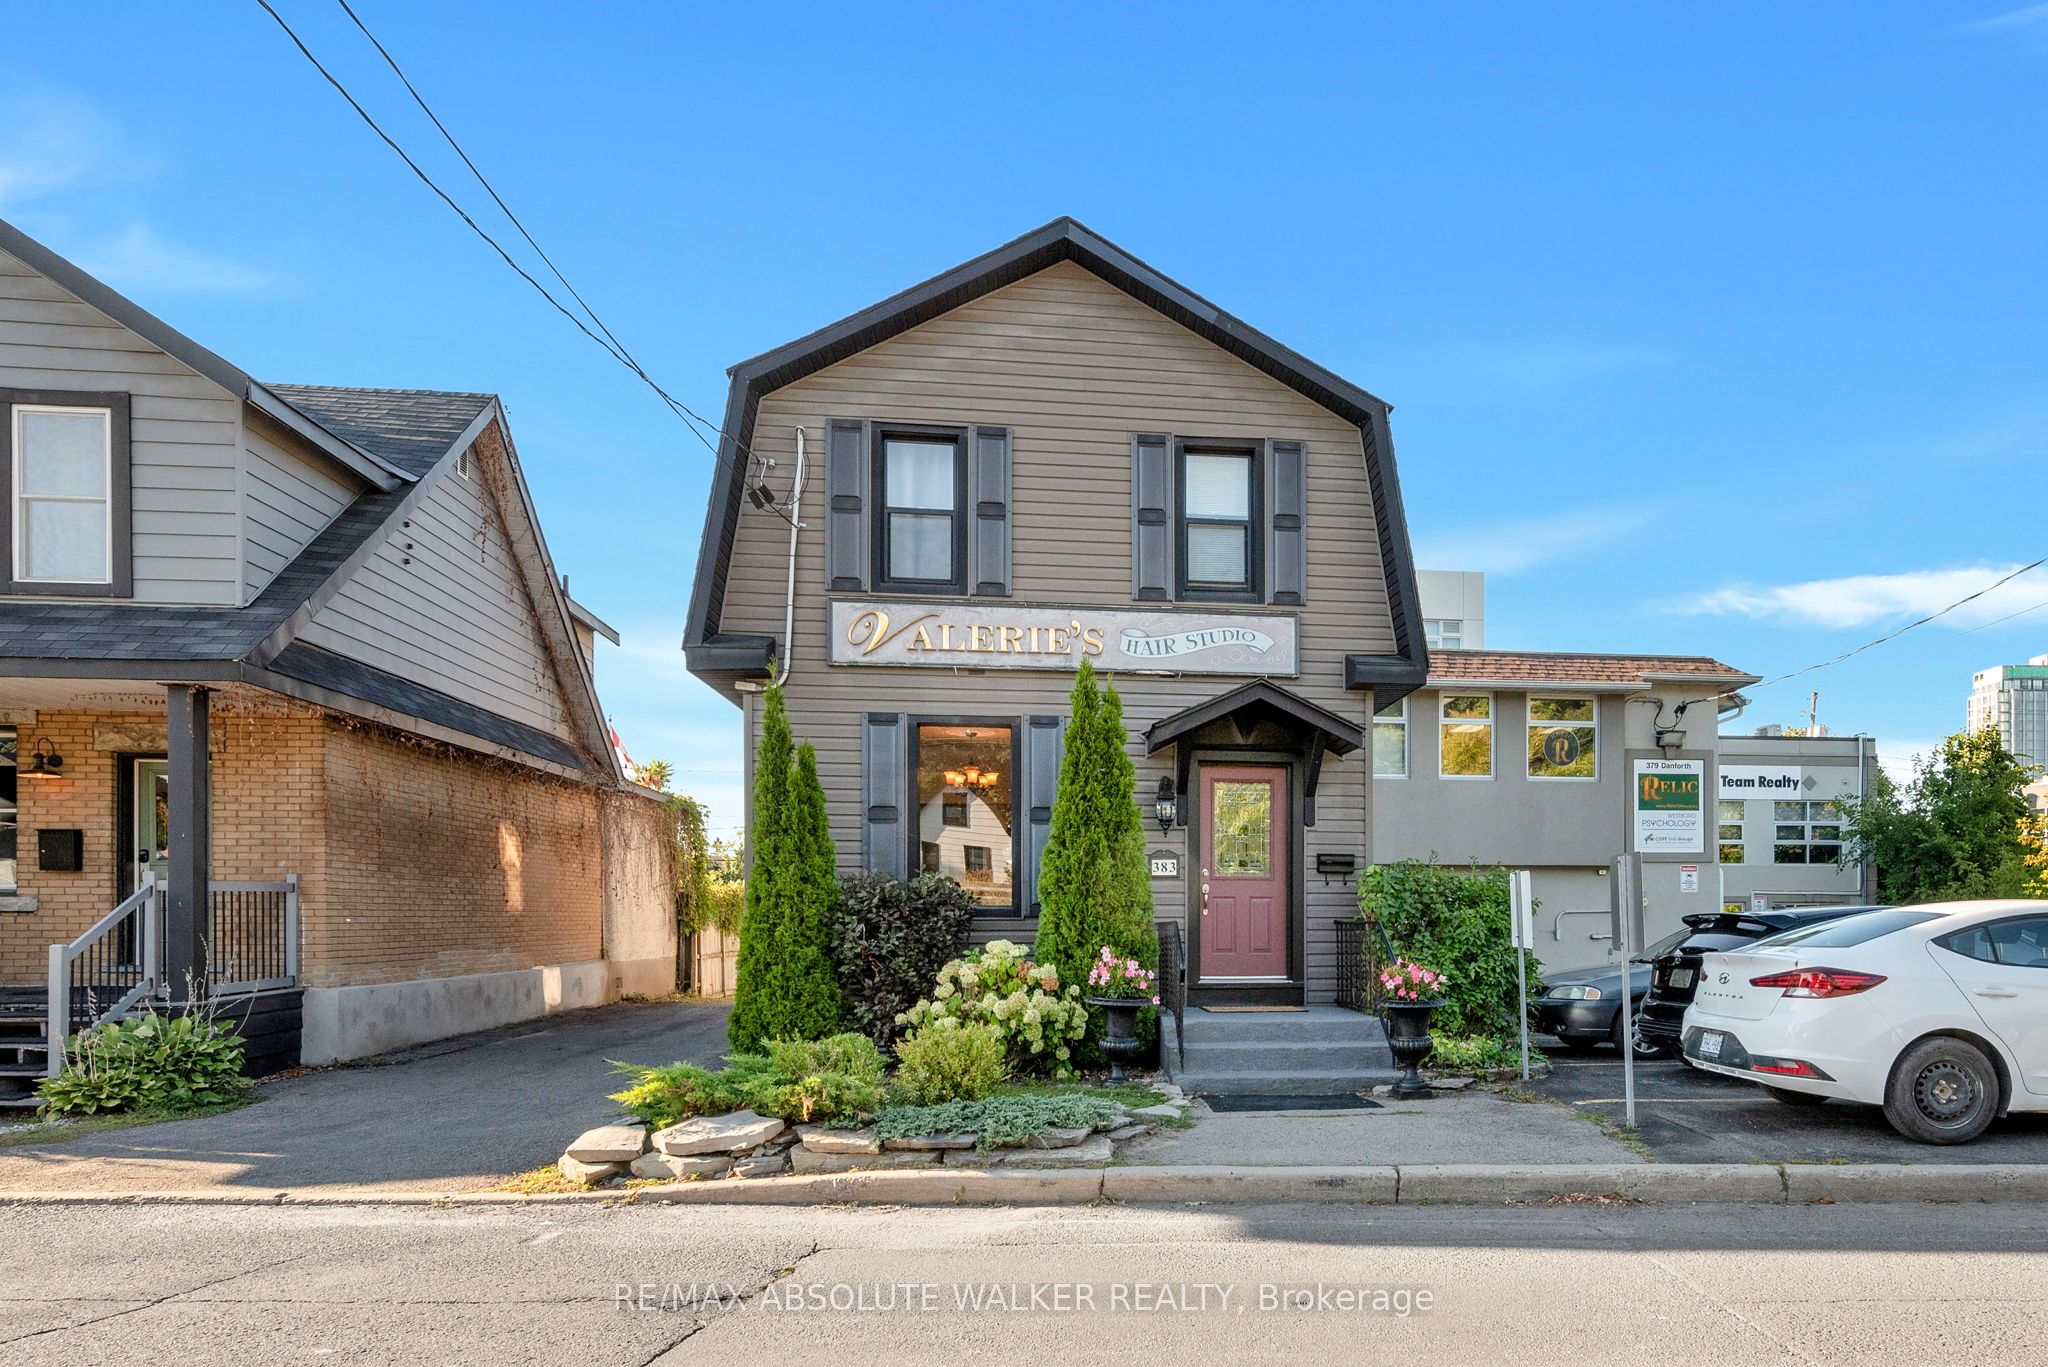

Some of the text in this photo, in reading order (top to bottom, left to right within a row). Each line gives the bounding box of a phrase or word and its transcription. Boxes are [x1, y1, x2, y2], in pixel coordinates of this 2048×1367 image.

[848, 611, 1104, 656] VALERIE'S
[1126, 629, 1256, 656] HAIR STUDIO
[1720, 775, 1800, 791] Team Realty
[1152, 862, 1177, 873] 383
